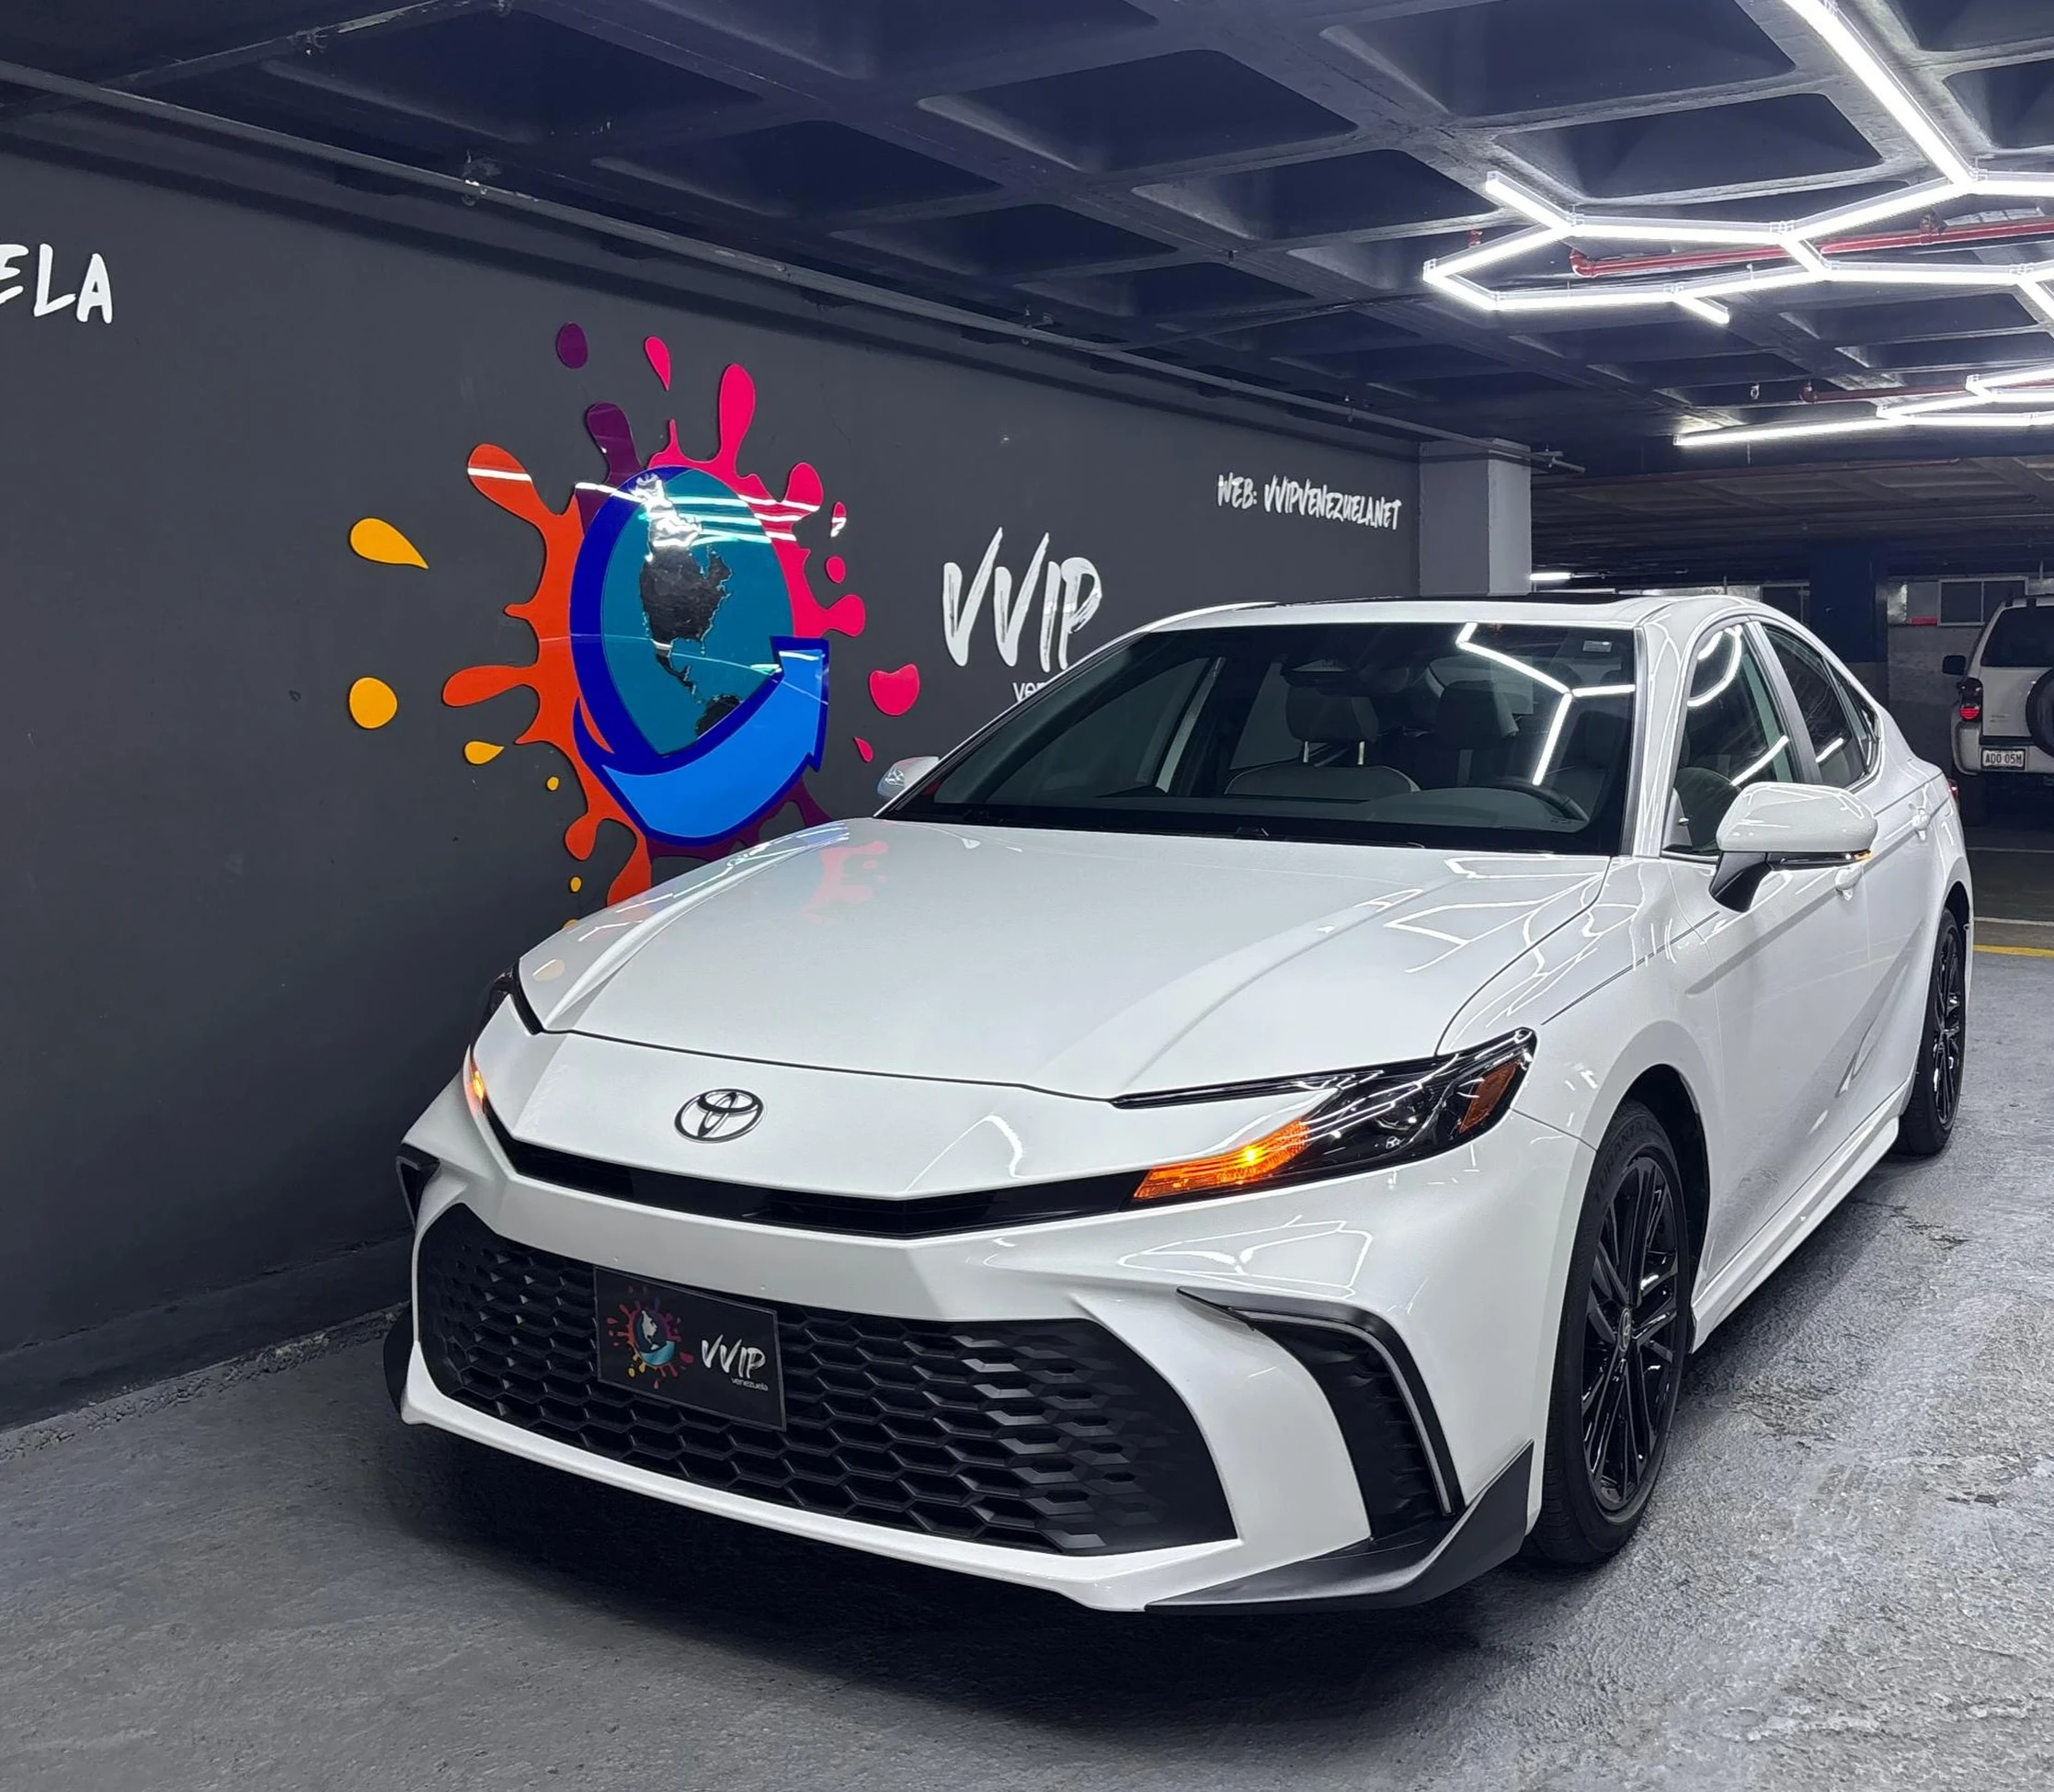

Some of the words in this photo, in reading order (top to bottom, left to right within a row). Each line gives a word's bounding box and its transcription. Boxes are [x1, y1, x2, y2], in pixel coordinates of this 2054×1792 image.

[1217, 472, 1257, 509] WEB:
[942, 527, 1102, 673] VVIP
[702, 1334, 766, 1379] VVIP
[731, 1376, 769, 1391] venezuela
